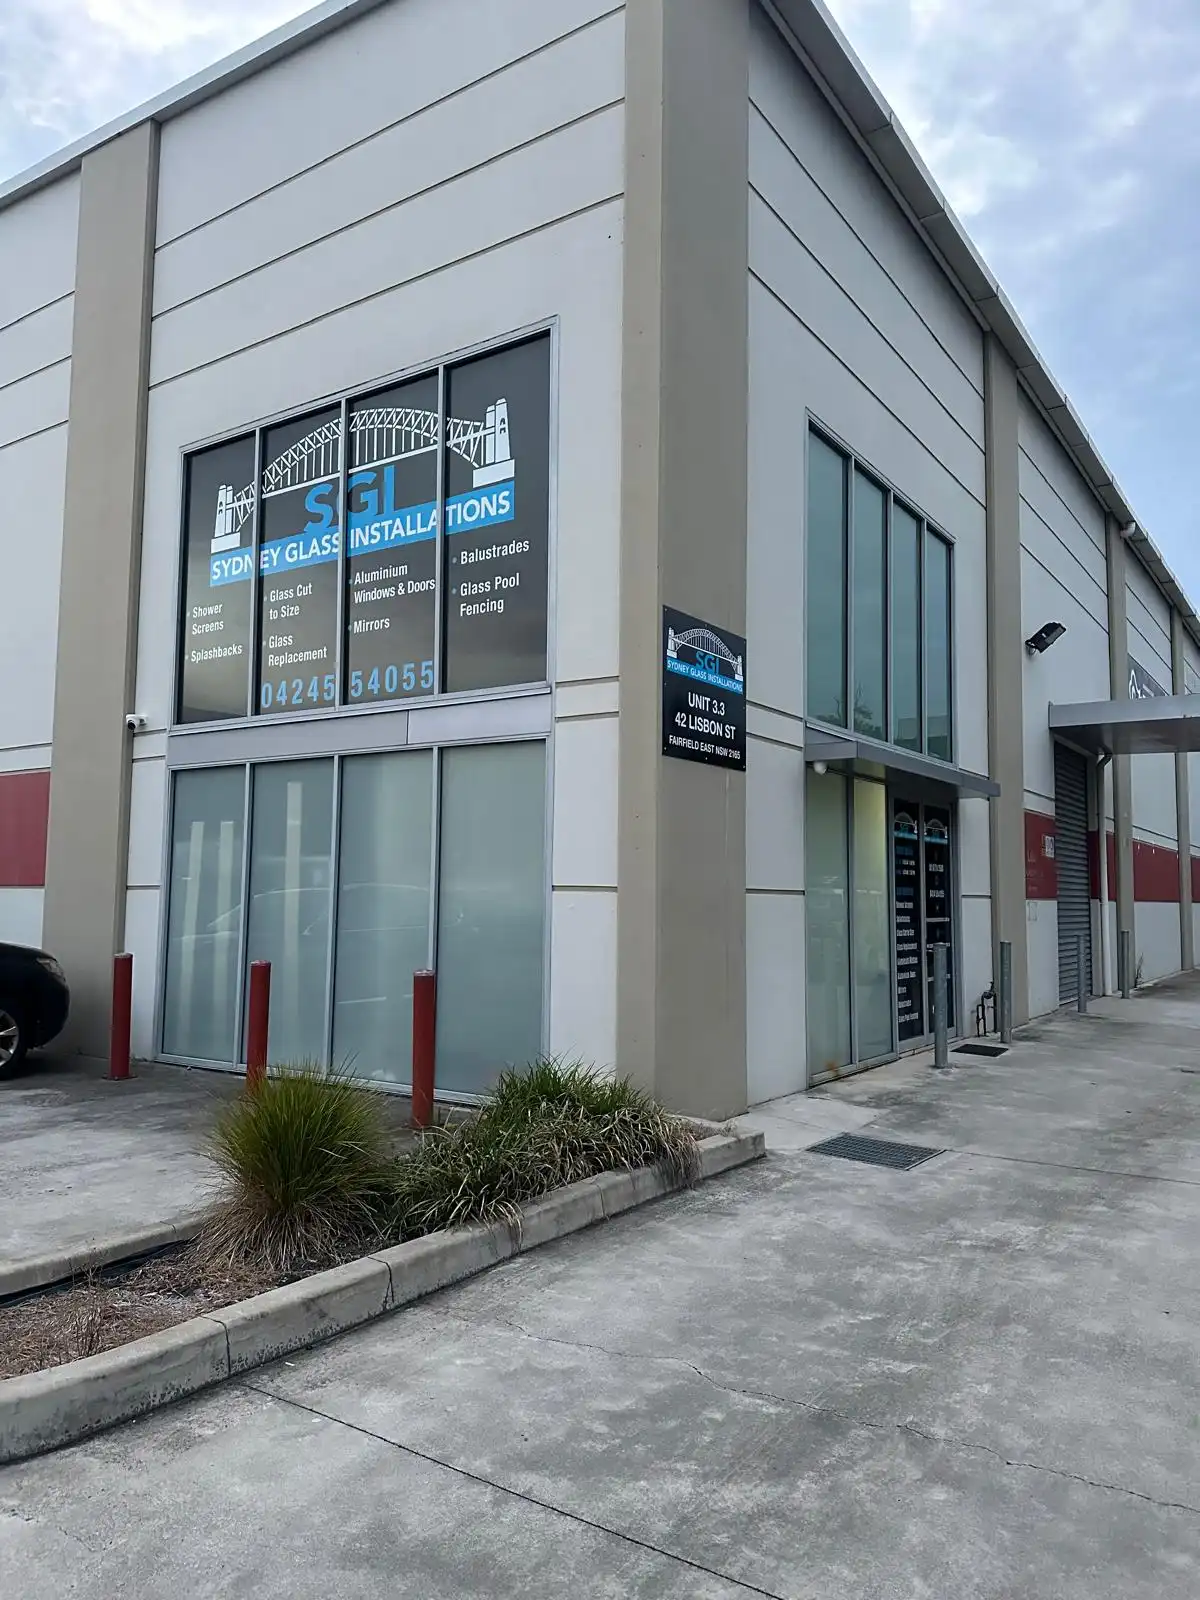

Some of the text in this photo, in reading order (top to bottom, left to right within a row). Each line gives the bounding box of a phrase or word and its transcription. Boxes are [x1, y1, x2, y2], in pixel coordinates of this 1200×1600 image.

[304, 465, 395, 535] SGI
[212, 491, 511, 580] SYDNEY GLASS INSTALLATIONS
[460, 540, 530, 564] Balustrades
[354, 564, 408, 585] Aluminium
[460, 572, 520, 597] Glass Pool
[270, 583, 313, 602] Glass Cut
[354, 578, 436, 604] Windows & Doors
[192, 603, 223, 618] Shower
[269, 605, 300, 620] to Size
[460, 599, 504, 617] Fencing
[192, 620, 224, 635] Screens
[353, 617, 390, 634] Mirrors
[269, 634, 293, 648] Glass
[191, 644, 243, 663] Splashbacks
[268, 646, 328, 667] Replacement
[696, 651, 719, 675] SGI
[261, 660, 434, 708] 04245 54055
[667, 660, 743, 692] SYDNEY GLASS INSTALLATIONS
[688, 691, 725, 716] UNIT 3.3
[675, 711, 736, 740] 42 LISBON ST
[669, 734, 741, 760] FAIRFIELD EAST NSW 2165
